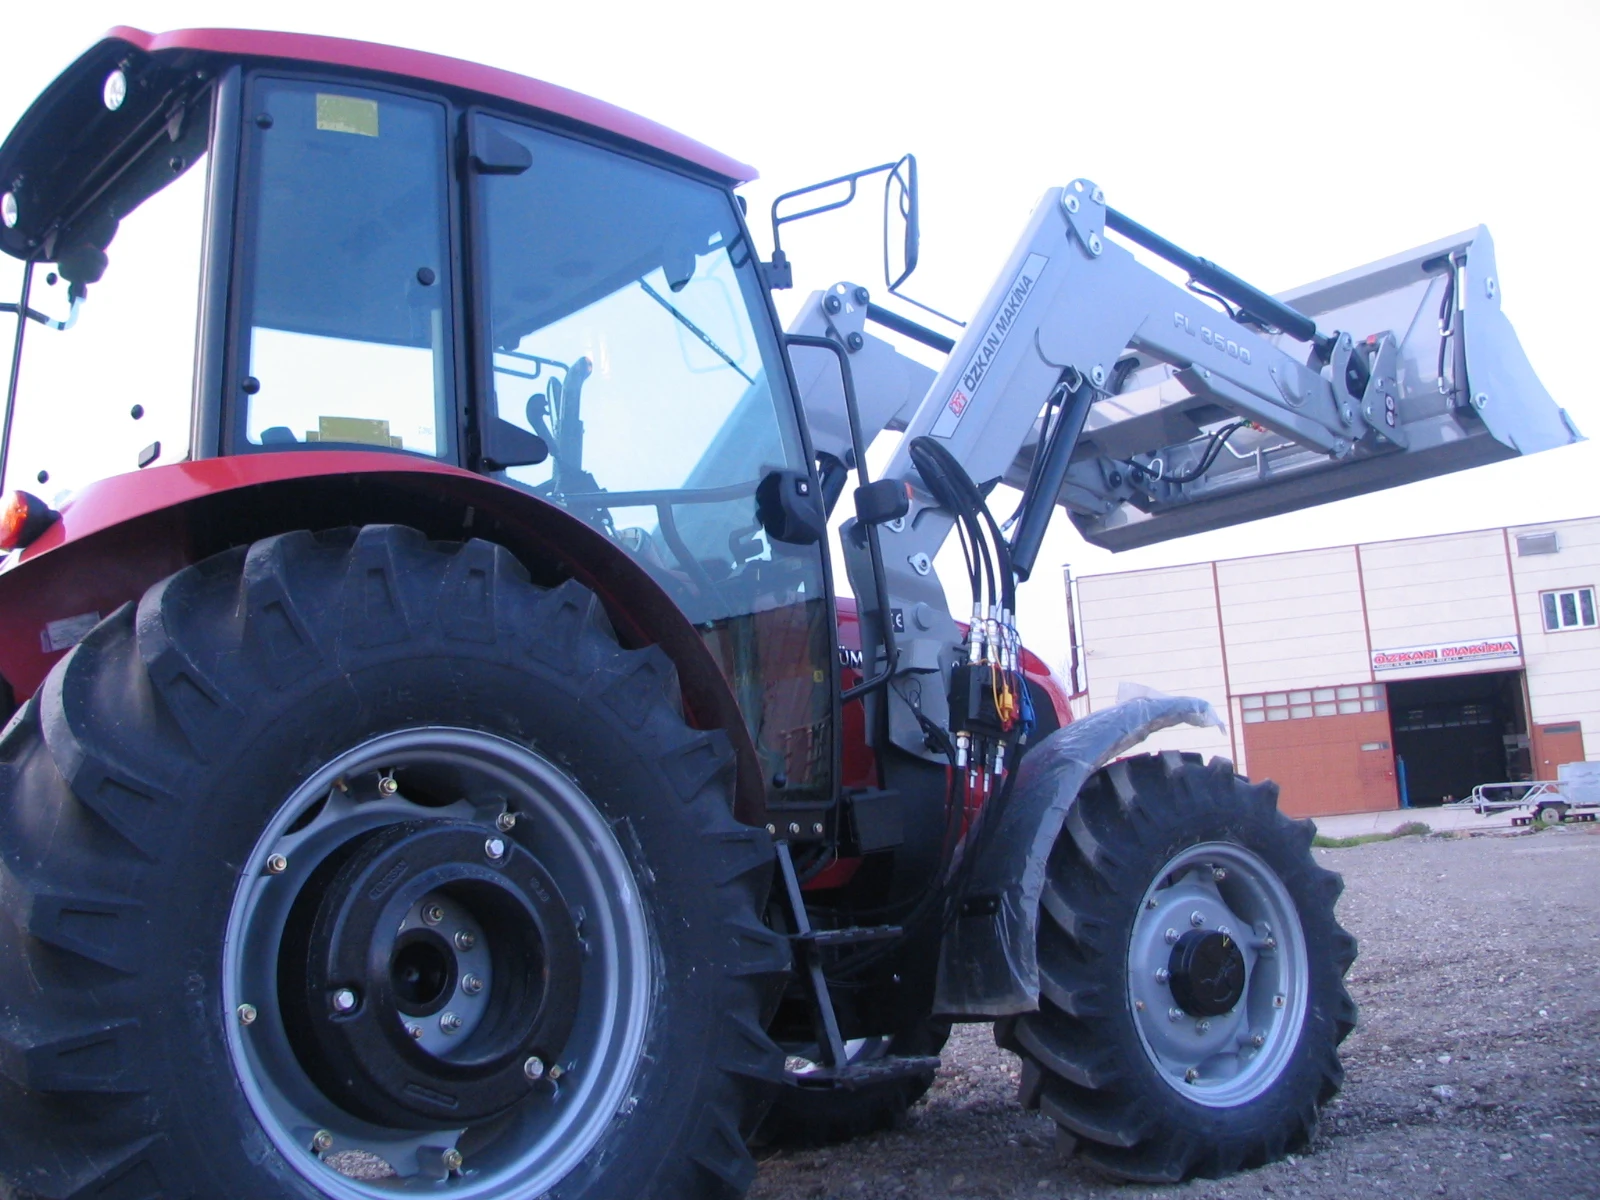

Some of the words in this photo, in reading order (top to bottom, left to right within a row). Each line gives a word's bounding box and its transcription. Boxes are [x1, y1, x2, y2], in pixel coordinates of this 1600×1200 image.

[964, 332, 1000, 393] ÖZKAN
[995, 275, 1034, 336] MAKİNA
[1173, 311, 1196, 337] FL
[1200, 326, 1252, 366] 3500
[1374, 650, 1437, 664] ÖZKAN
[1441, 641, 1515, 657] MAKİNA
